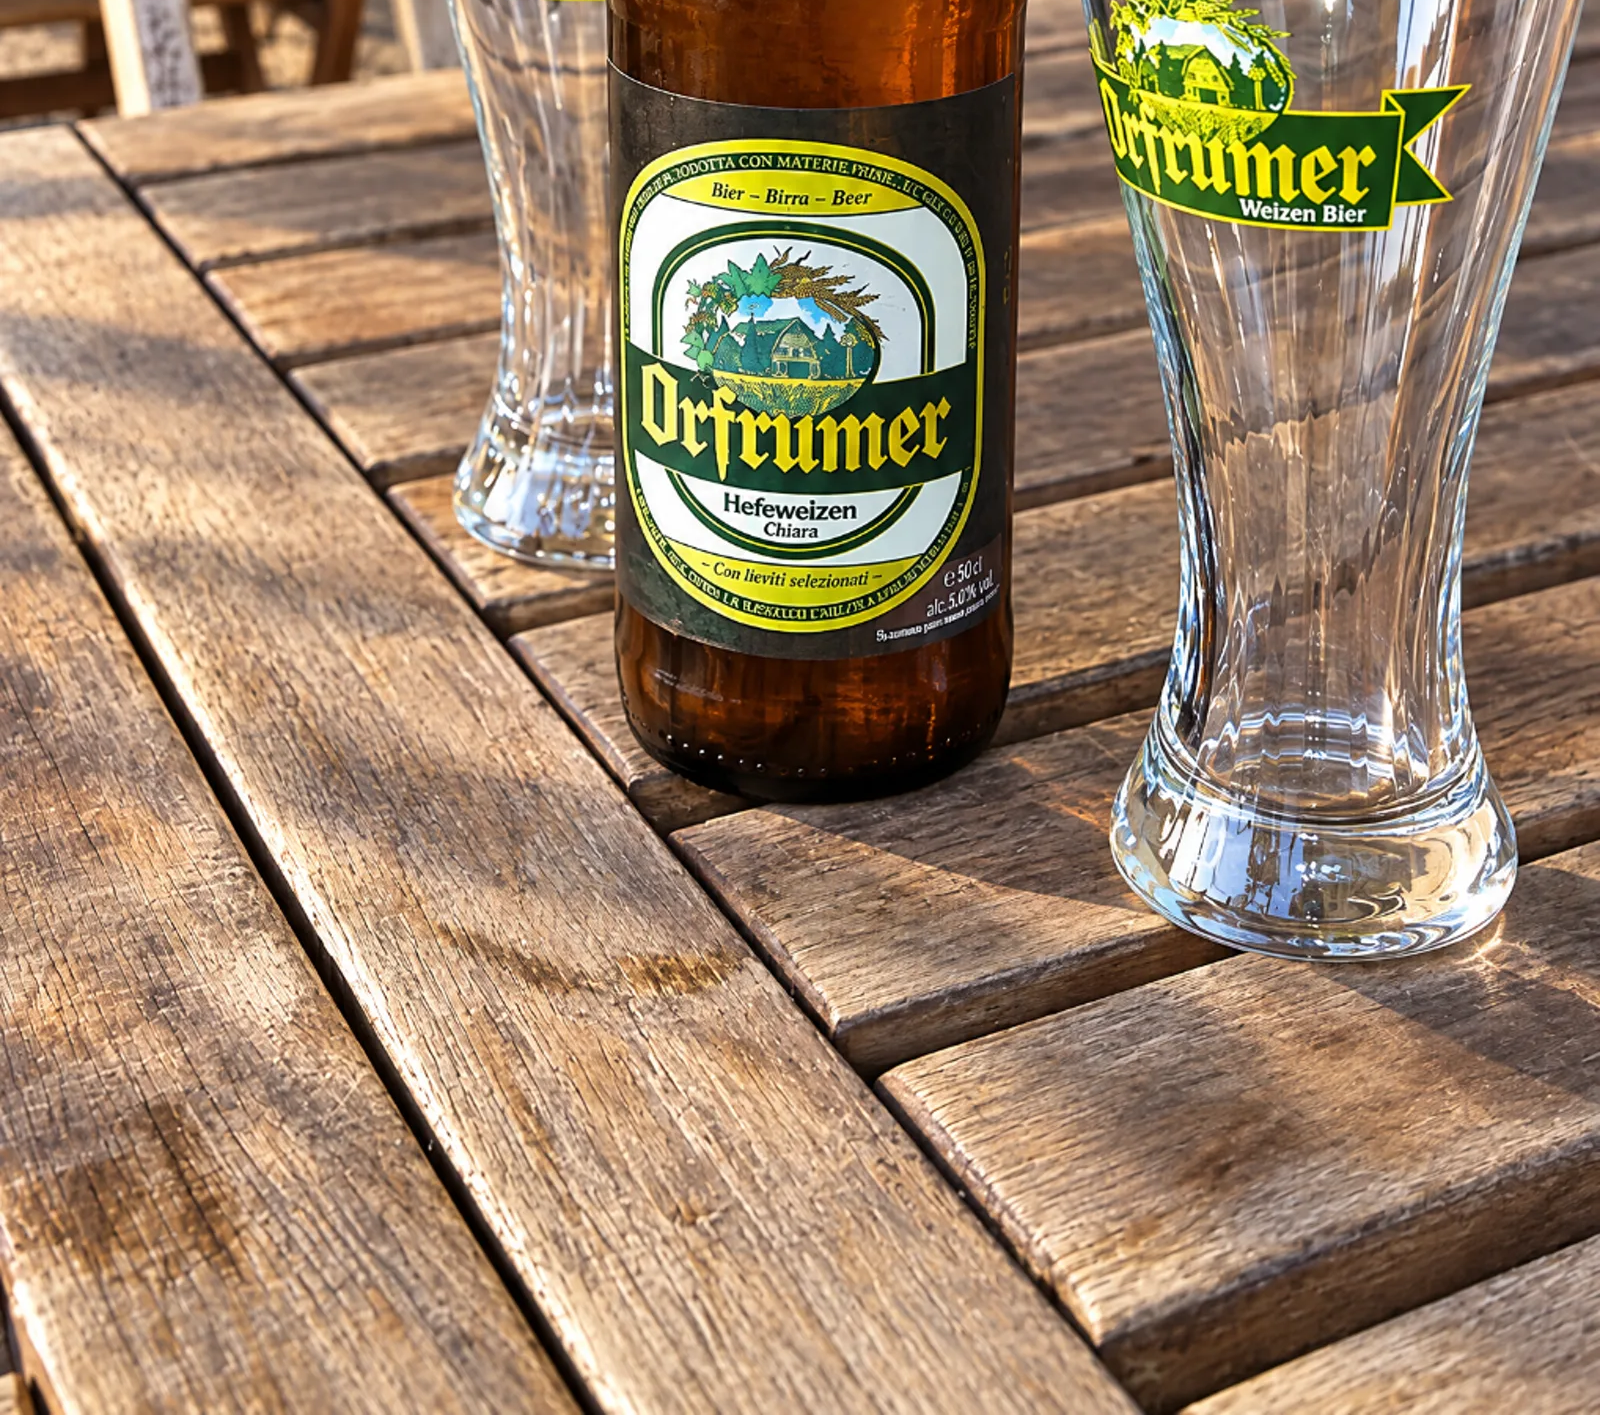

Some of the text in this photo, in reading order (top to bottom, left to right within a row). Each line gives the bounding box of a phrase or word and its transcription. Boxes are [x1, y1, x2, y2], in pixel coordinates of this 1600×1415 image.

[1100, 78, 1377, 205] Orfrumer
[738, 155, 773, 168] CON
[711, 181, 746, 201] Bier
[765, 188, 809, 206] Birra
[831, 190, 873, 206] Beer
[1239, 198, 1367, 223] Weizen Bier
[640, 362, 952, 483] Orfrumer
[723, 492, 858, 522] Hefeweizen
[763, 522, 819, 539] Chiara
[713, 561, 869, 590] Con lieviti selezionati
